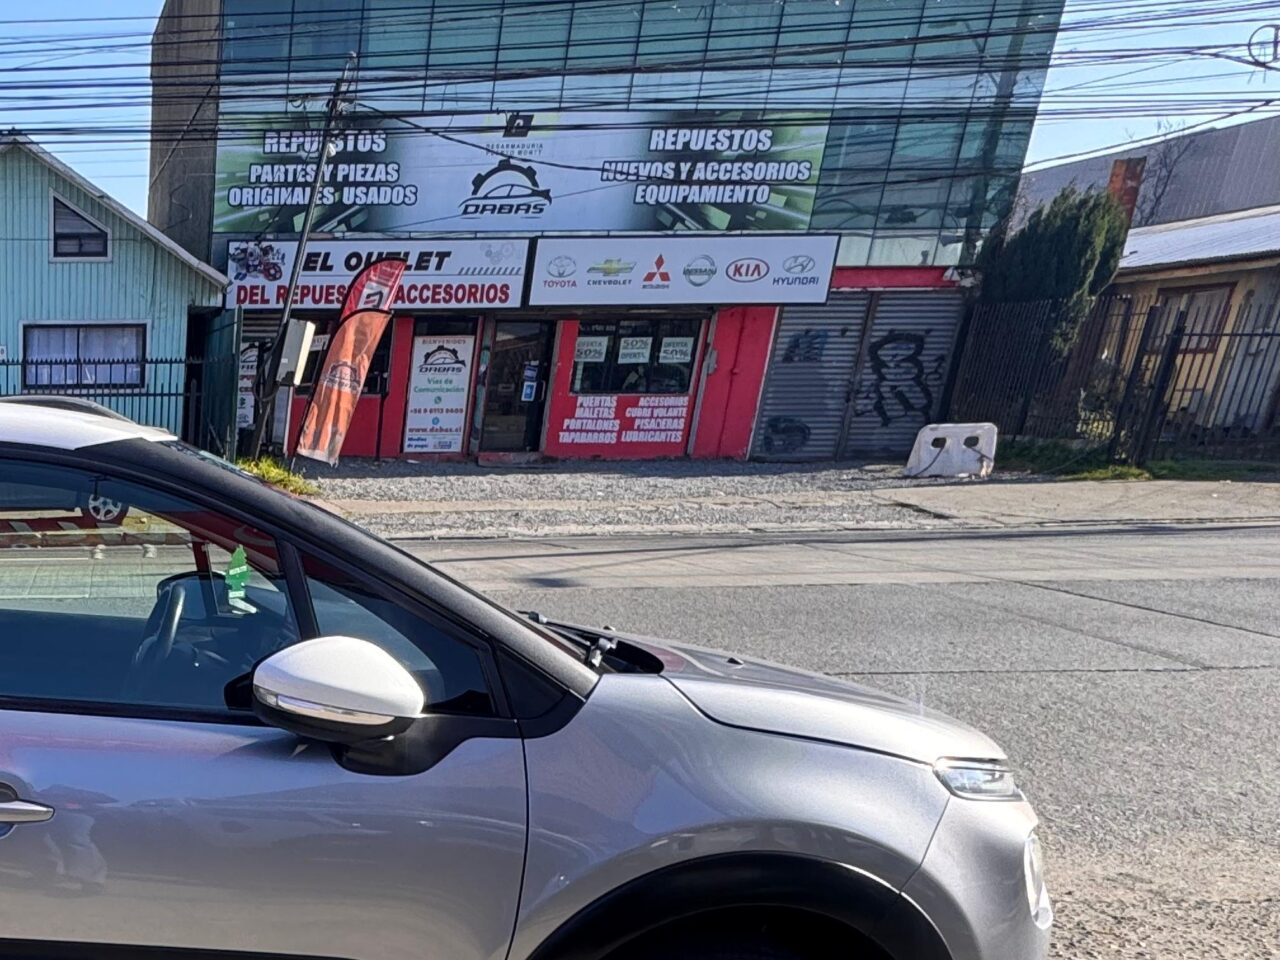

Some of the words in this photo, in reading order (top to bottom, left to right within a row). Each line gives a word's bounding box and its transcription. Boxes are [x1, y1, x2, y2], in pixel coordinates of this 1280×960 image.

[263, 129, 388, 153] REPUSTOS
[649, 129, 773, 151] REPUESTOS
[249, 163, 318, 183] PARTES
[322, 163, 335, 183] Y
[336, 163, 400, 183] PIEZAS
[601, 161, 675, 181] NUEVOS
[679, 161, 693, 181] Y
[693, 161, 812, 181] ACCESORIOS
[341, 186, 418, 205] USADOS
[634, 184, 770, 204] EQUIPAMIENTO
[460, 203, 546, 215] DABAS
[302, 251, 334, 272] EL
[732, 263, 762, 277] KIA
[543, 279, 578, 288] TOYOTA
[772, 276, 819, 285] HYUNDAI
[236, 284, 271, 305] DEL
[396, 284, 510, 305] ACCESORIOS
[622, 339, 649, 349] 50%
[576, 348, 603, 358] 50%
[662, 349, 689, 357] 50%
[577, 396, 618, 408] PUERTAS
[638, 396, 689, 407] ACCESORIOS
[575, 407, 616, 419] MALETAS
[625, 407, 652, 417] CUBRE
[652, 407, 688, 417] VOLANTE
[563, 419, 620, 431] PORTALONES
[634, 418, 685, 430] PISADERAS
[559, 431, 618, 444] TAPABARROS
[621, 431, 683, 443] LUBRICANTES
